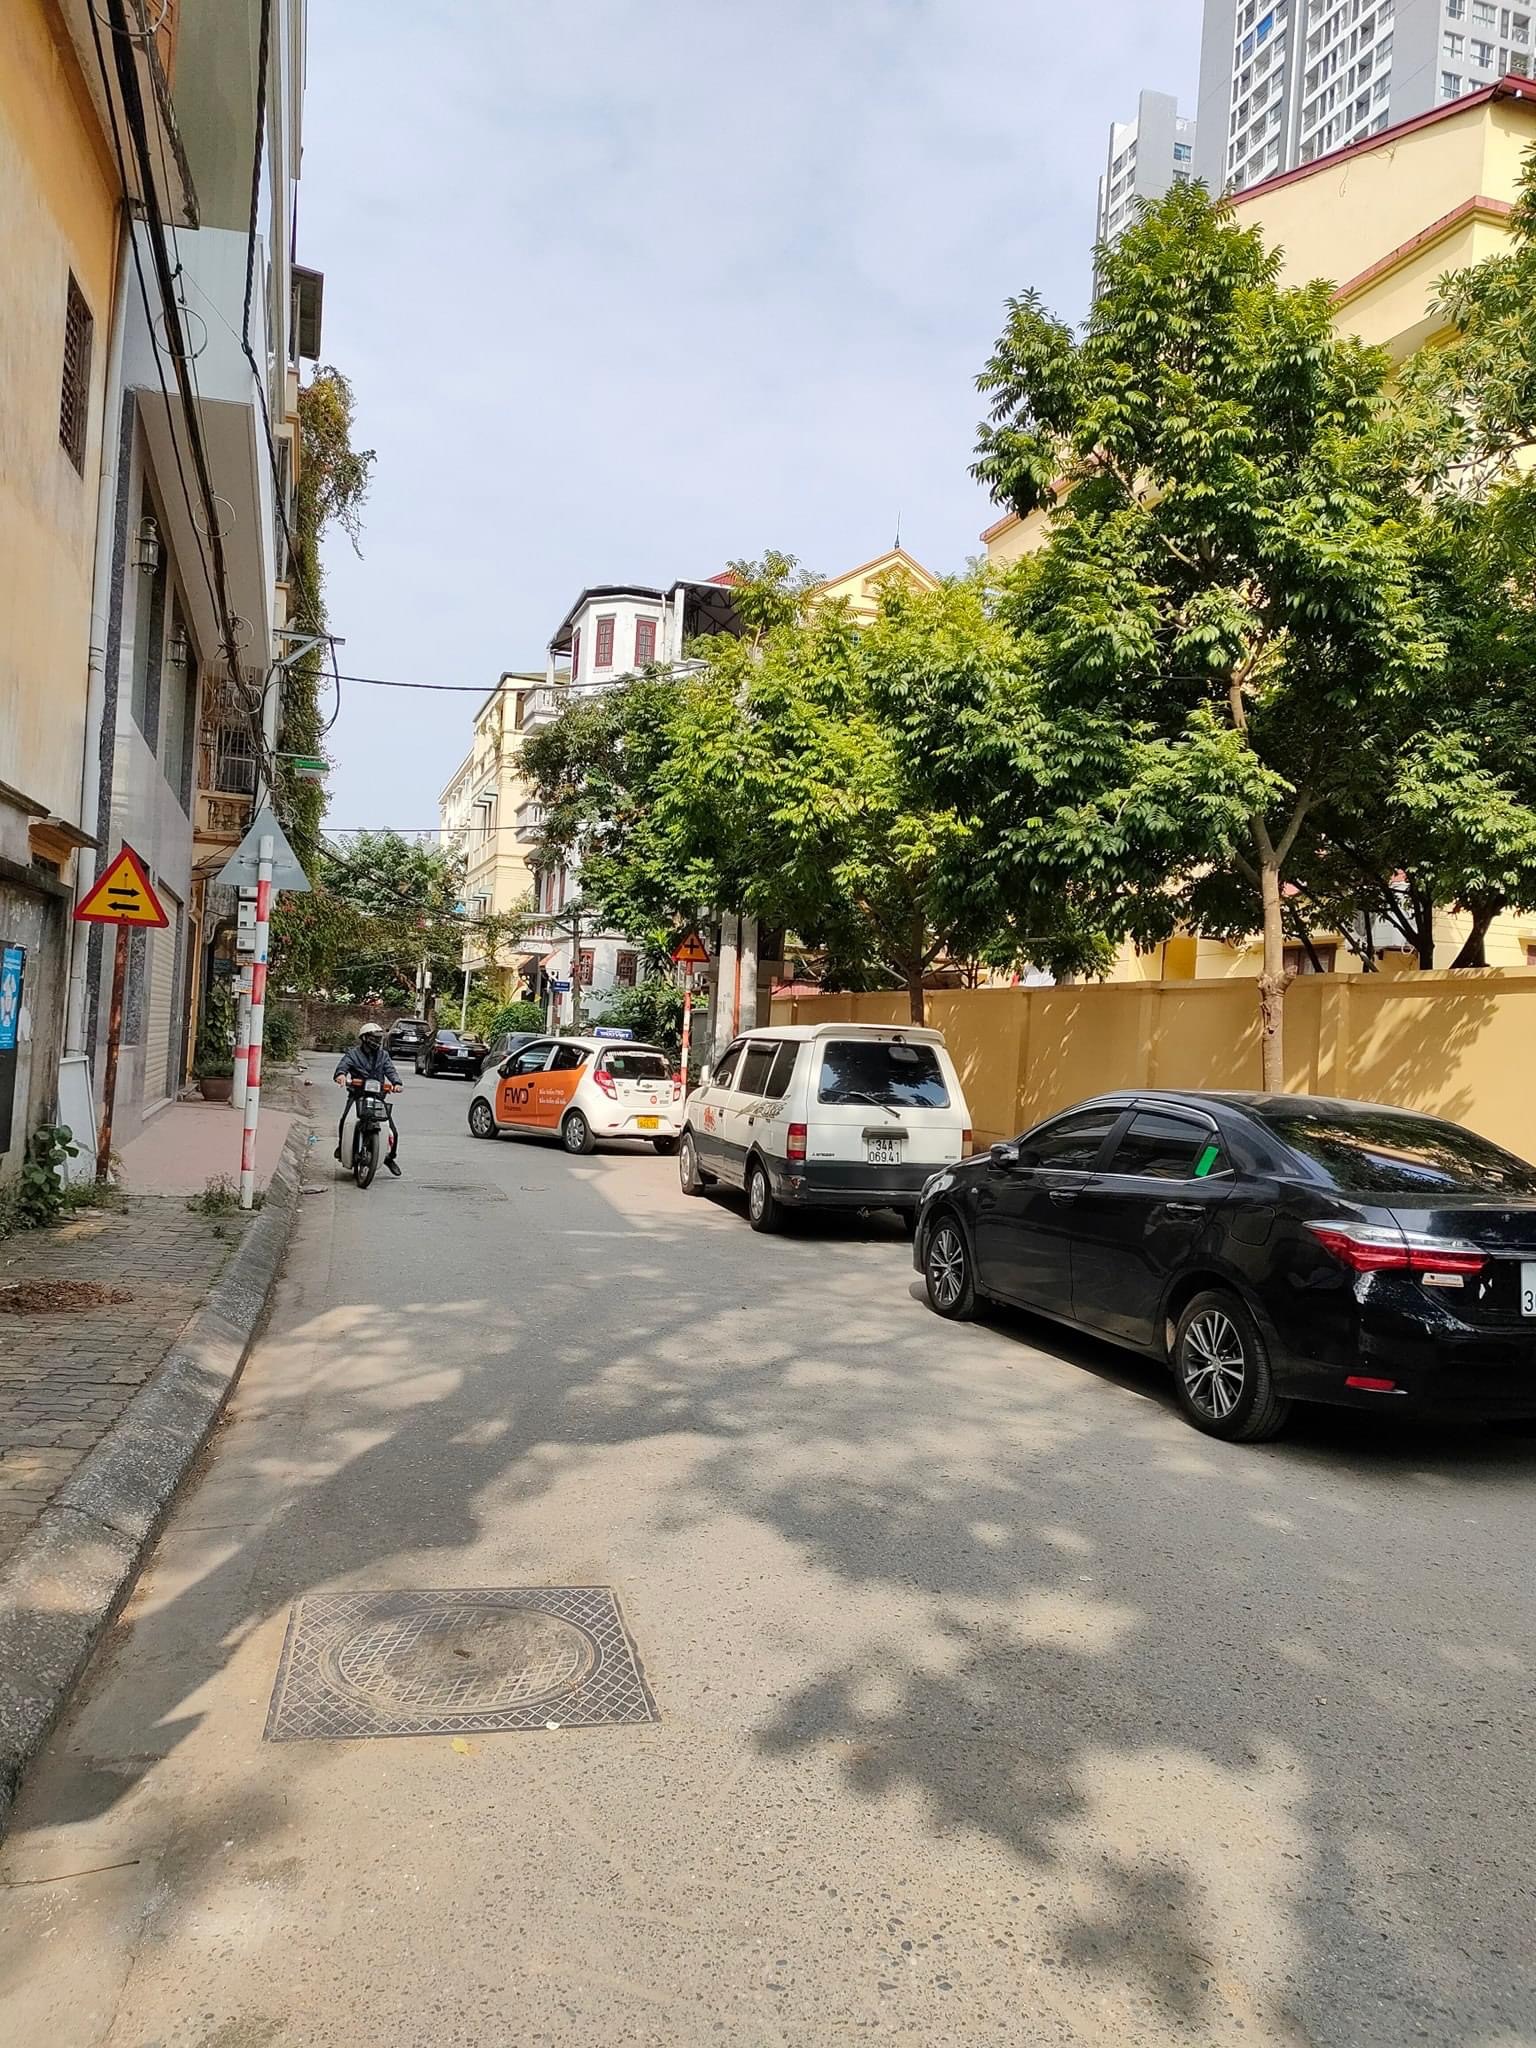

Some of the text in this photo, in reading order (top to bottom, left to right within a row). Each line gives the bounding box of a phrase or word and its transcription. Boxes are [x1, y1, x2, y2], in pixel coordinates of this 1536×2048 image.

[504, 1087, 529, 1104] FWD
[875, 1139, 894, 1151] 34A
[1524, 1290, 1536, 1312] 3
